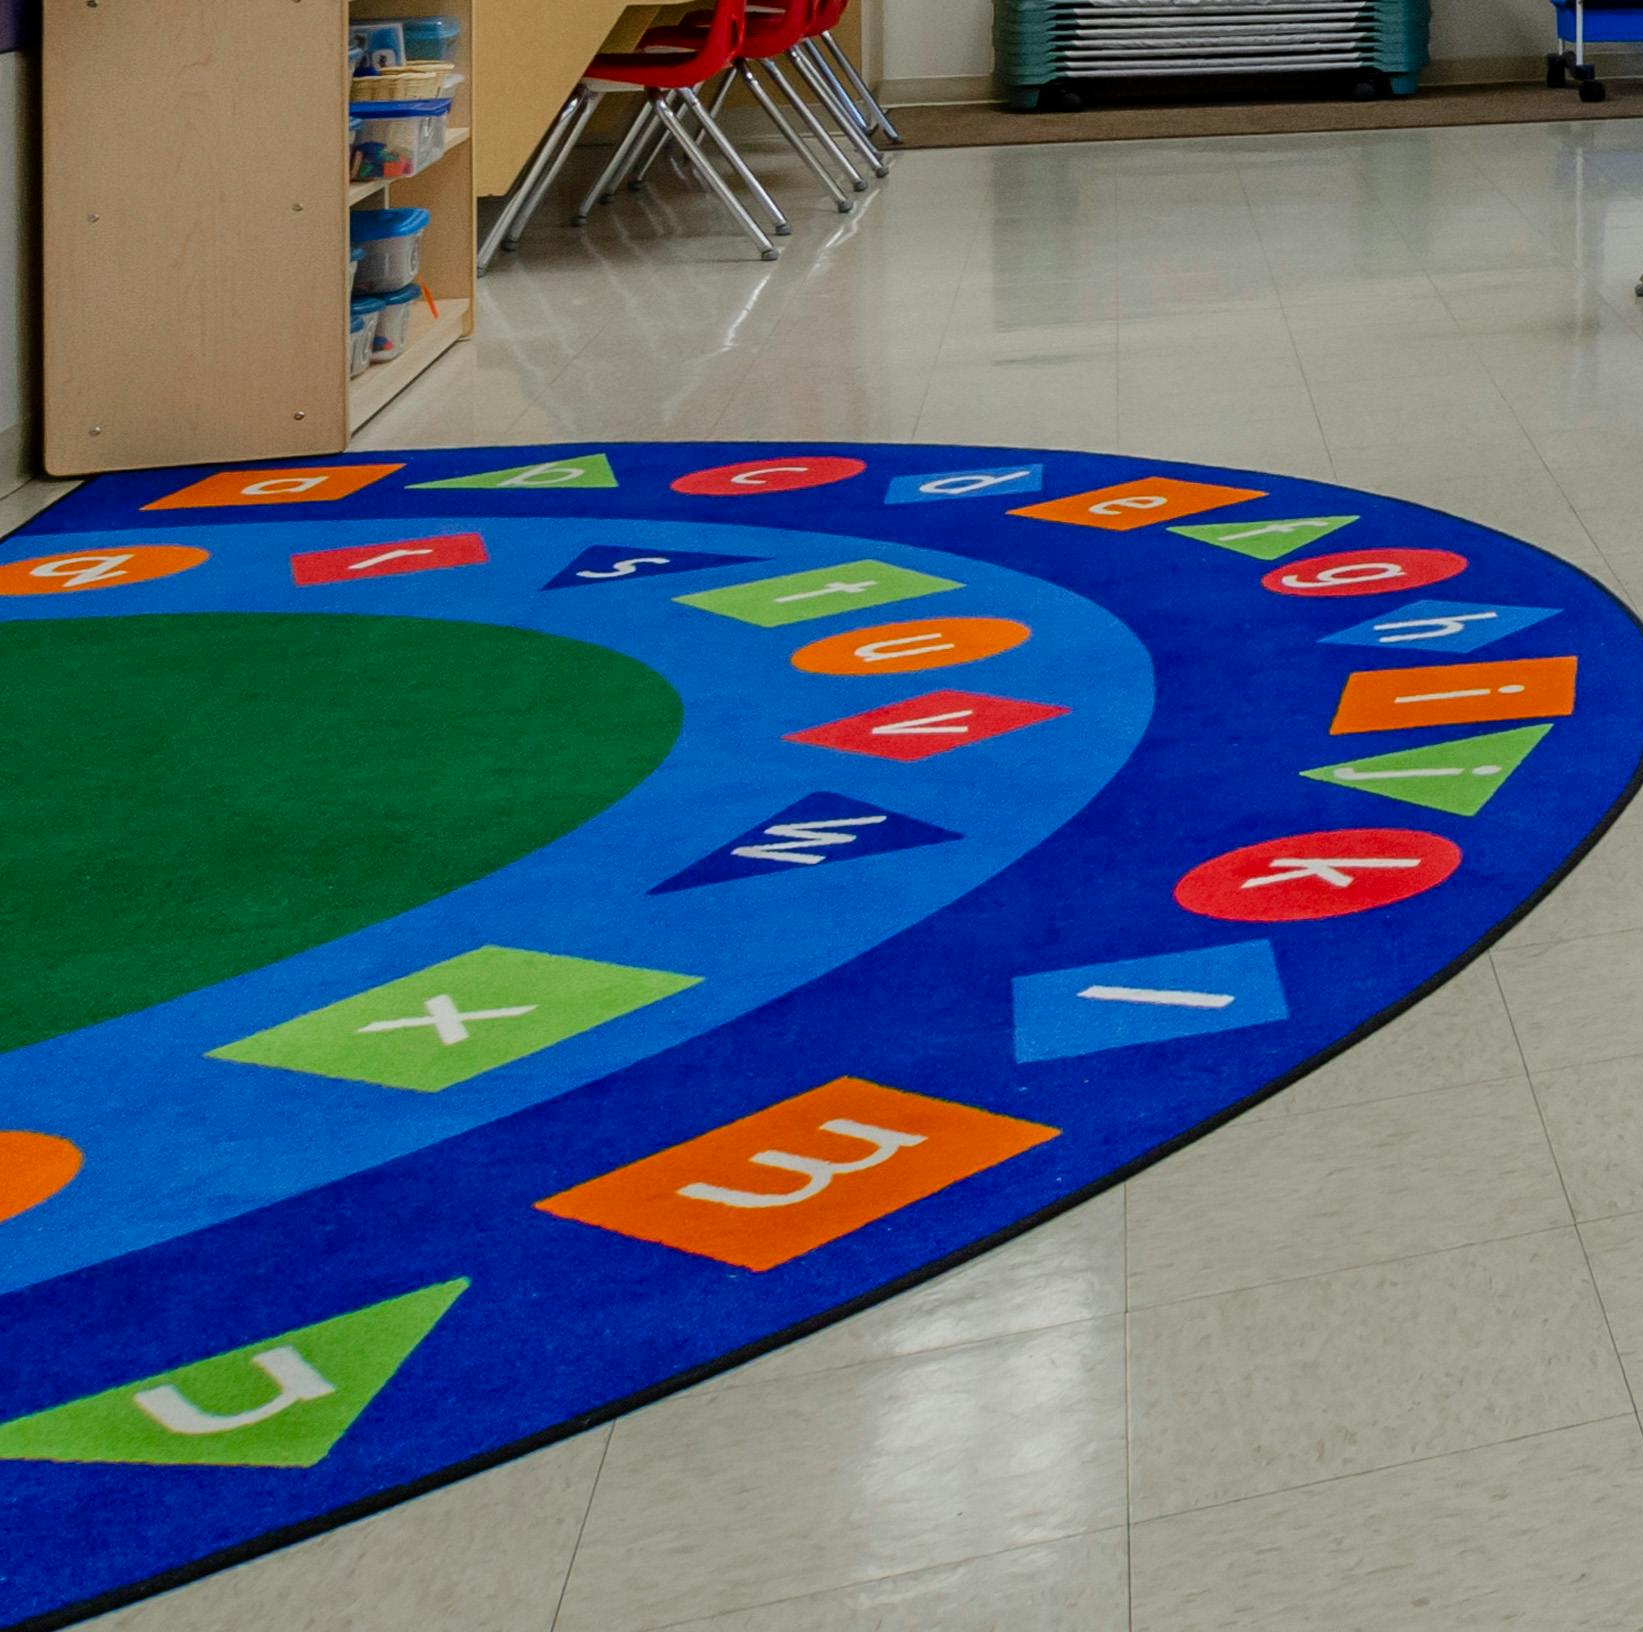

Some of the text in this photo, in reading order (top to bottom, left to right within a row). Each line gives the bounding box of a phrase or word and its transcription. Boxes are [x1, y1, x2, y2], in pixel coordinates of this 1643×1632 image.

[242, 475, 329, 497] a
[496, 461, 586, 488] b
[731, 466, 809, 485] c
[917, 471, 1031, 495] d
[1089, 494, 1169, 516] e
[1214, 517, 1331, 542] f
[347, 549, 434, 570] r
[577, 557, 671, 578] s
[1281, 562, 1409, 589] g
[774, 580, 880, 604] t
[1373, 611, 1500, 644] h
[870, 710, 970, 738] v
[1240, 857, 1423, 890] k
[356, 993, 540, 1047] x
